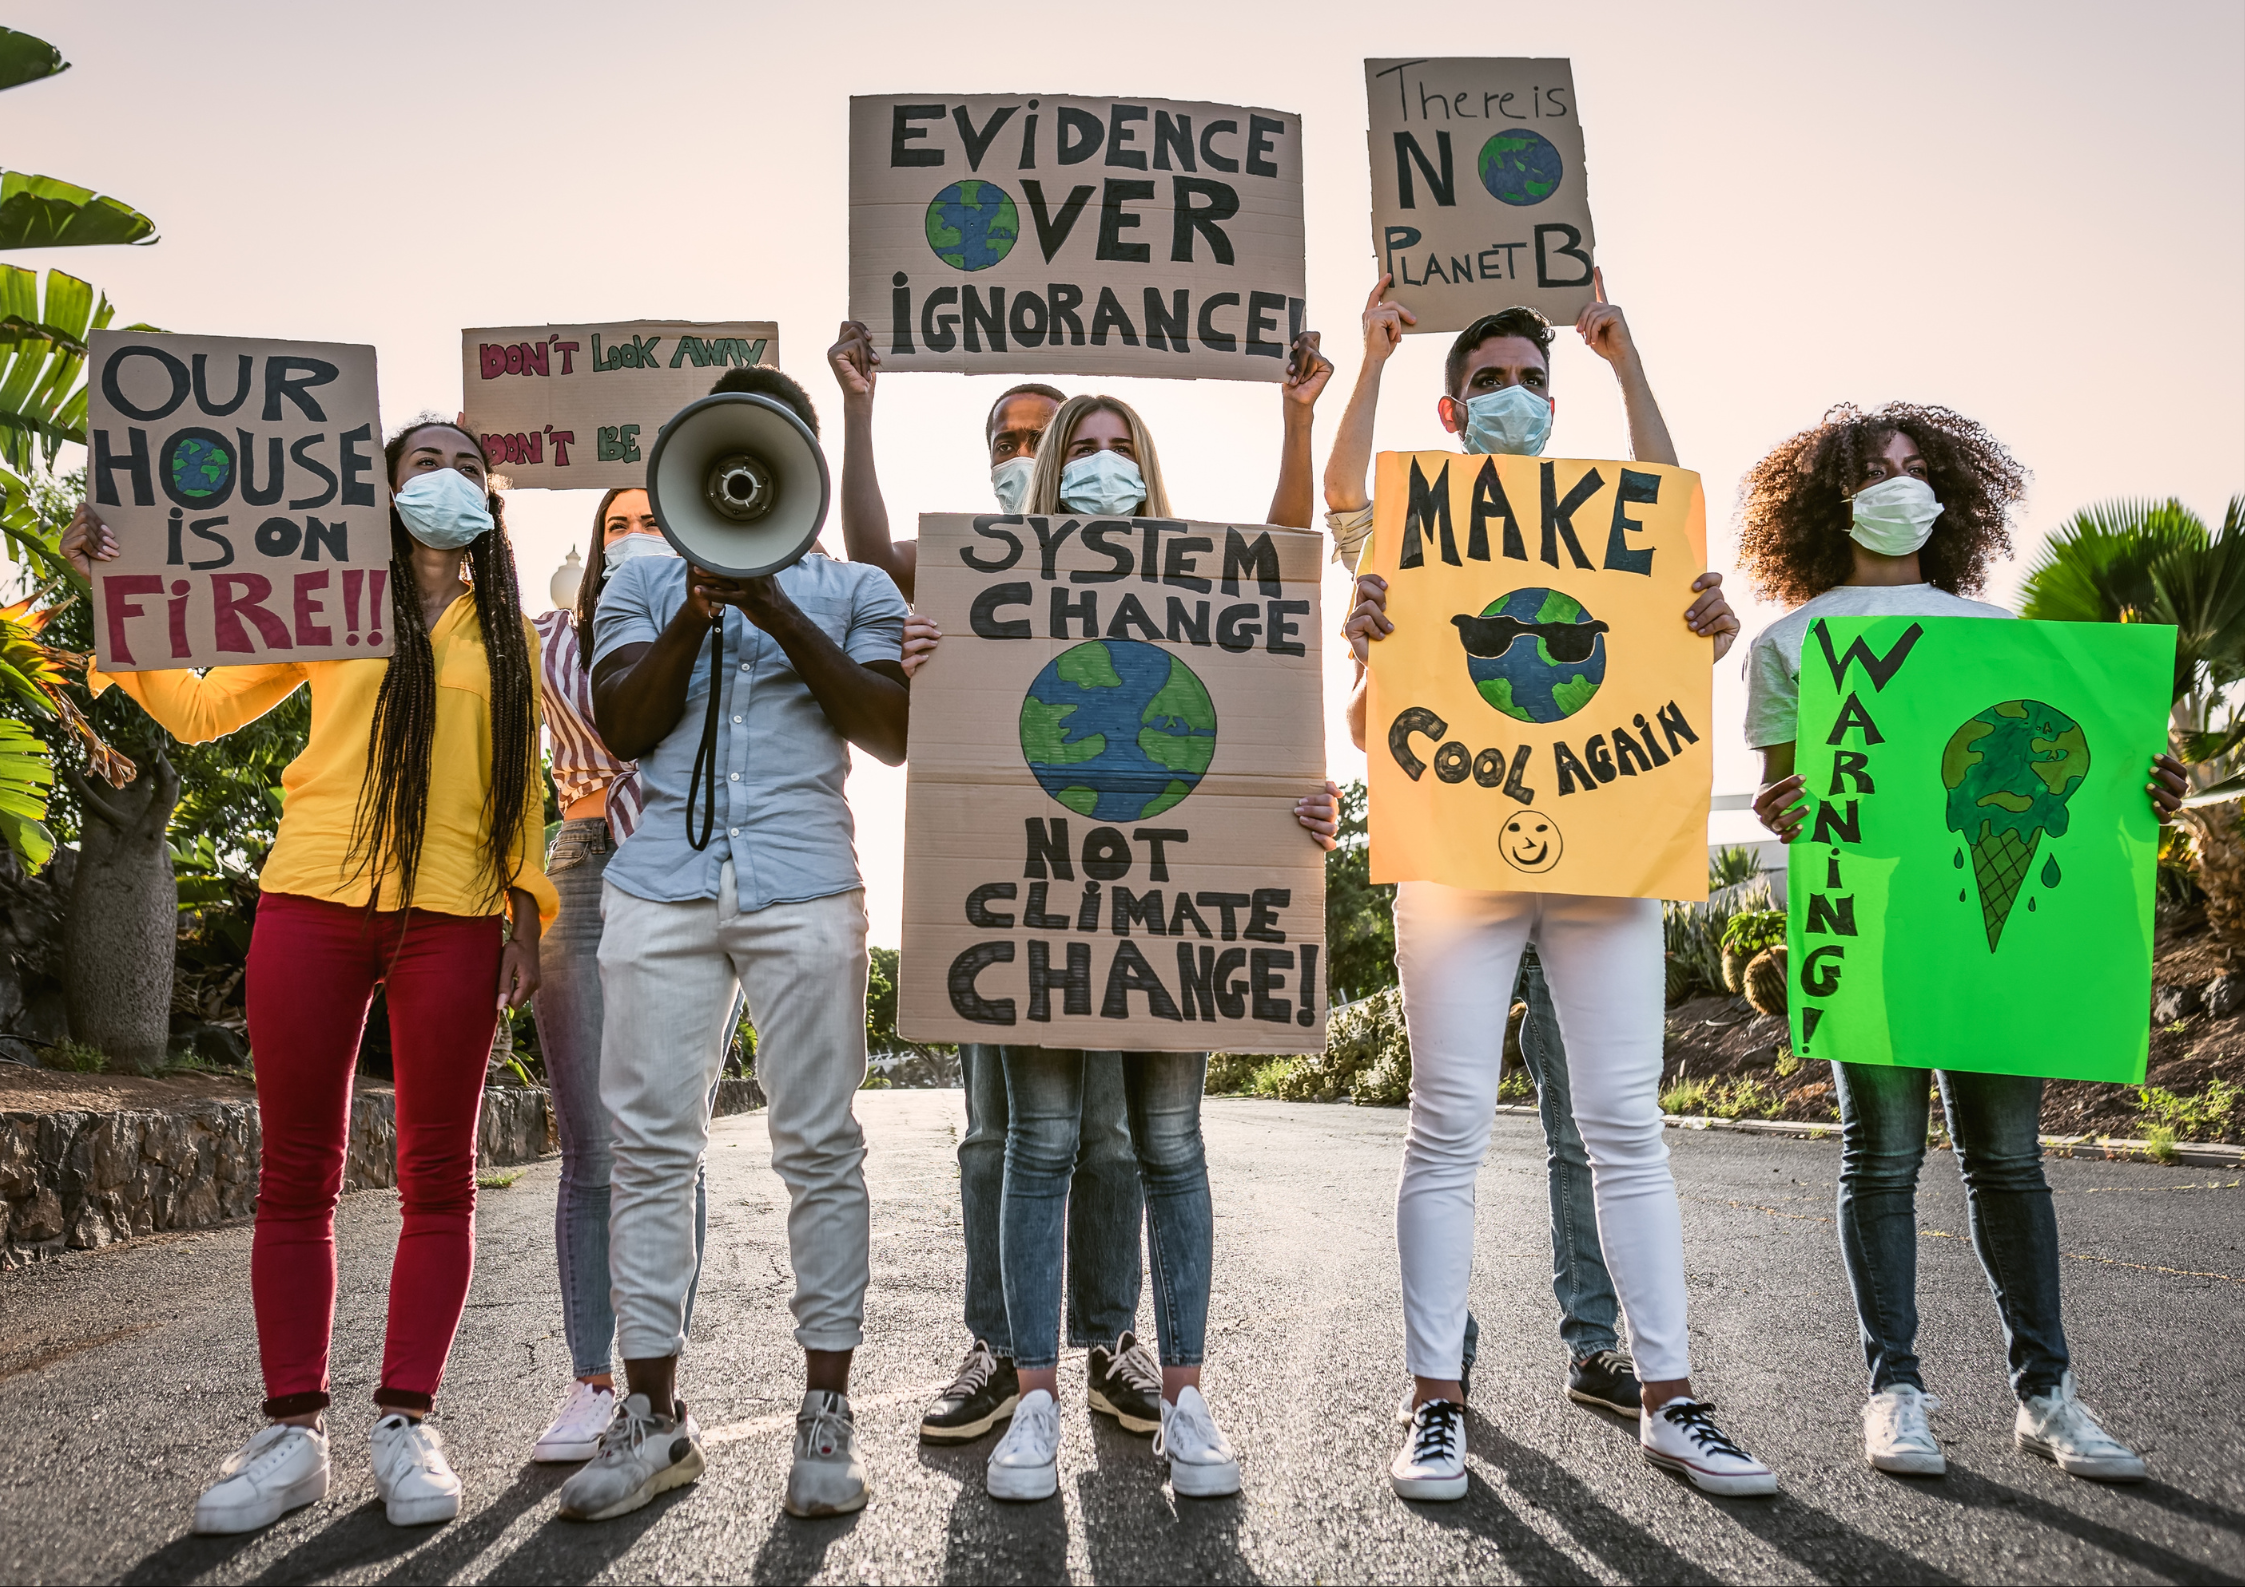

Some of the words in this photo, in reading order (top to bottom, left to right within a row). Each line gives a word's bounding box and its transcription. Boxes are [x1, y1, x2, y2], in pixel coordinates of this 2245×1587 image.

[1375, 59, 1527, 122] There
[1384, 225, 1528, 288] PLANET
[1533, 222, 1594, 288] B
[101, 345, 340, 422] OUR
[479, 334, 580, 380] DON'T
[668, 335, 768, 369] AWAY
[93, 422, 376, 511] HOUSE
[481, 424, 575, 467] DON'T
[597, 424, 641, 464] BE
[254, 515, 350, 562] ON
[1399, 454, 1663, 577] MAKE
[959, 514, 1283, 600] SYSTEM
[969, 581, 1311, 658] CHANGE
[1387, 706, 1536, 806] COOL
[1022, 816, 1190, 882] NOT
[946, 939, 1320, 1028] CHANGE!
